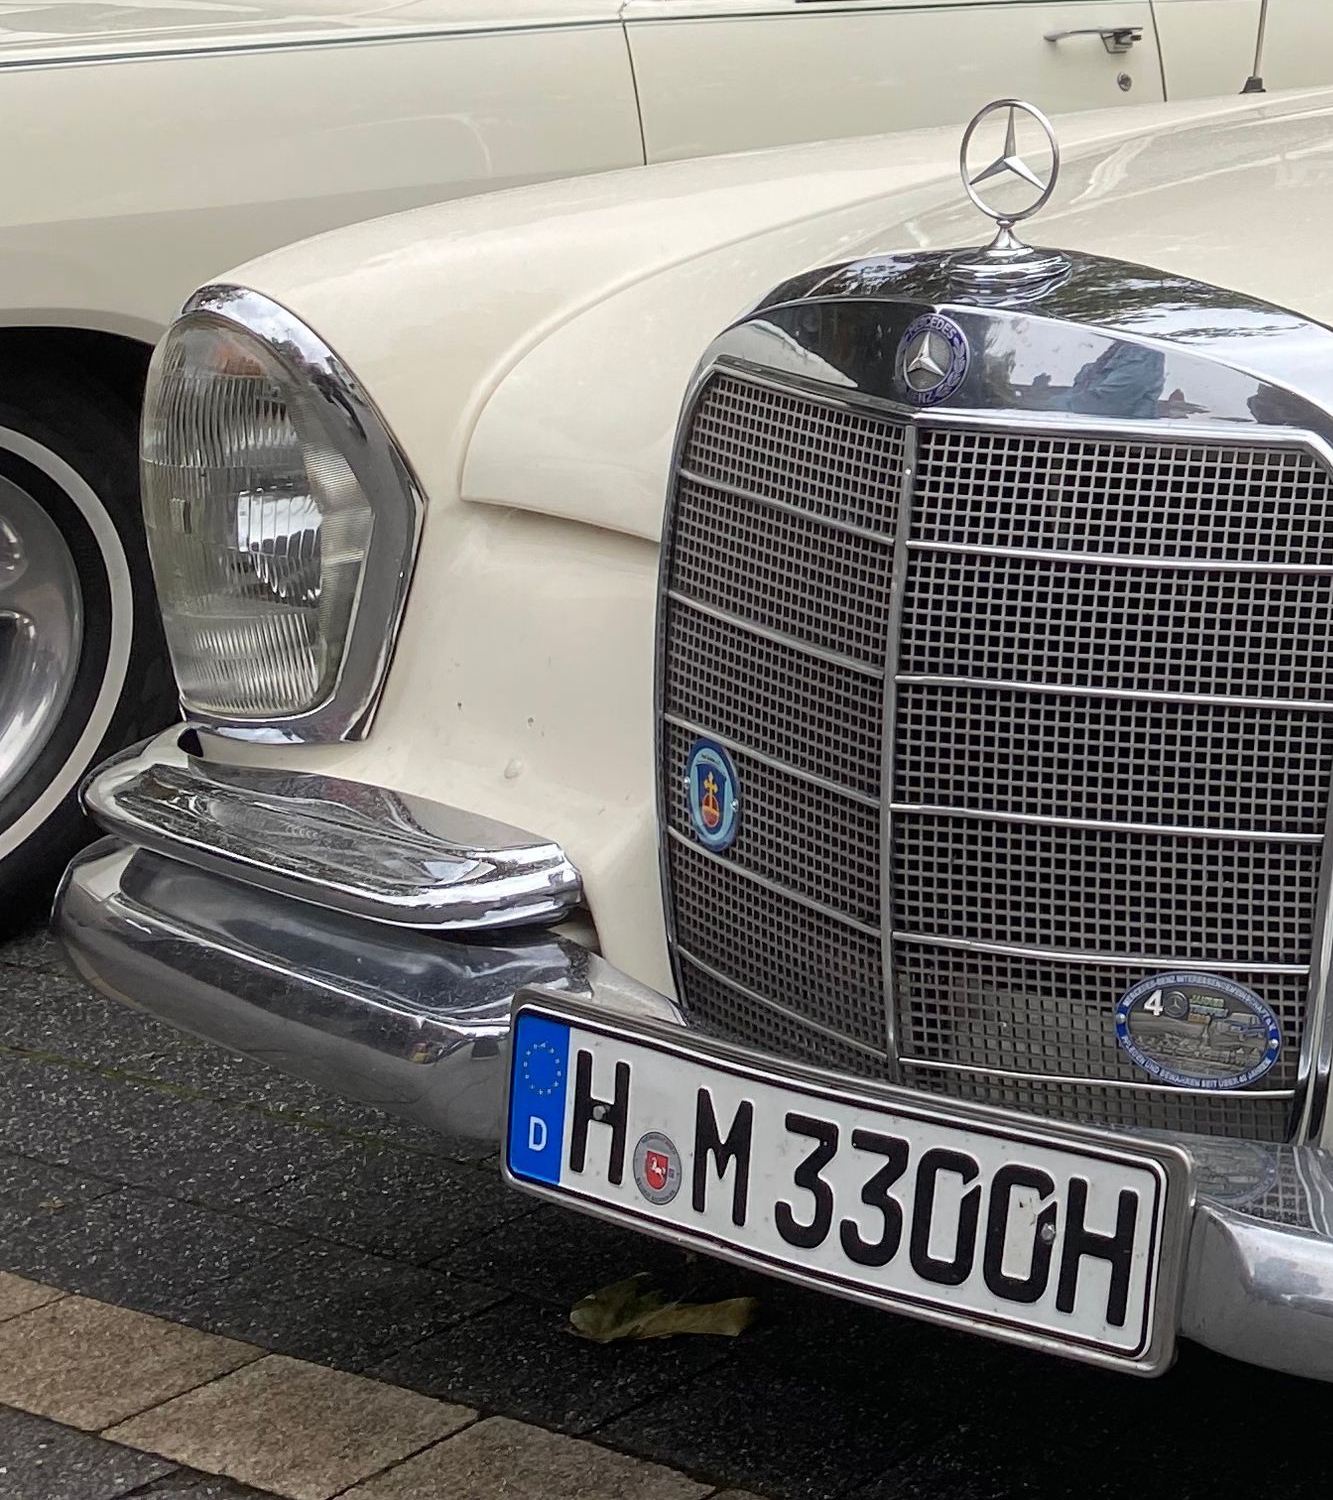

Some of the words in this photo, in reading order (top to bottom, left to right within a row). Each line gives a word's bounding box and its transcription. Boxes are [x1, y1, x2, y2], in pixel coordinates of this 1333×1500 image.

[527, 1116, 548, 1152] D
[570, 1049, 631, 1185] H
[692, 1087, 754, 1227] M
[774, 1112, 1139, 1327] 3300H
